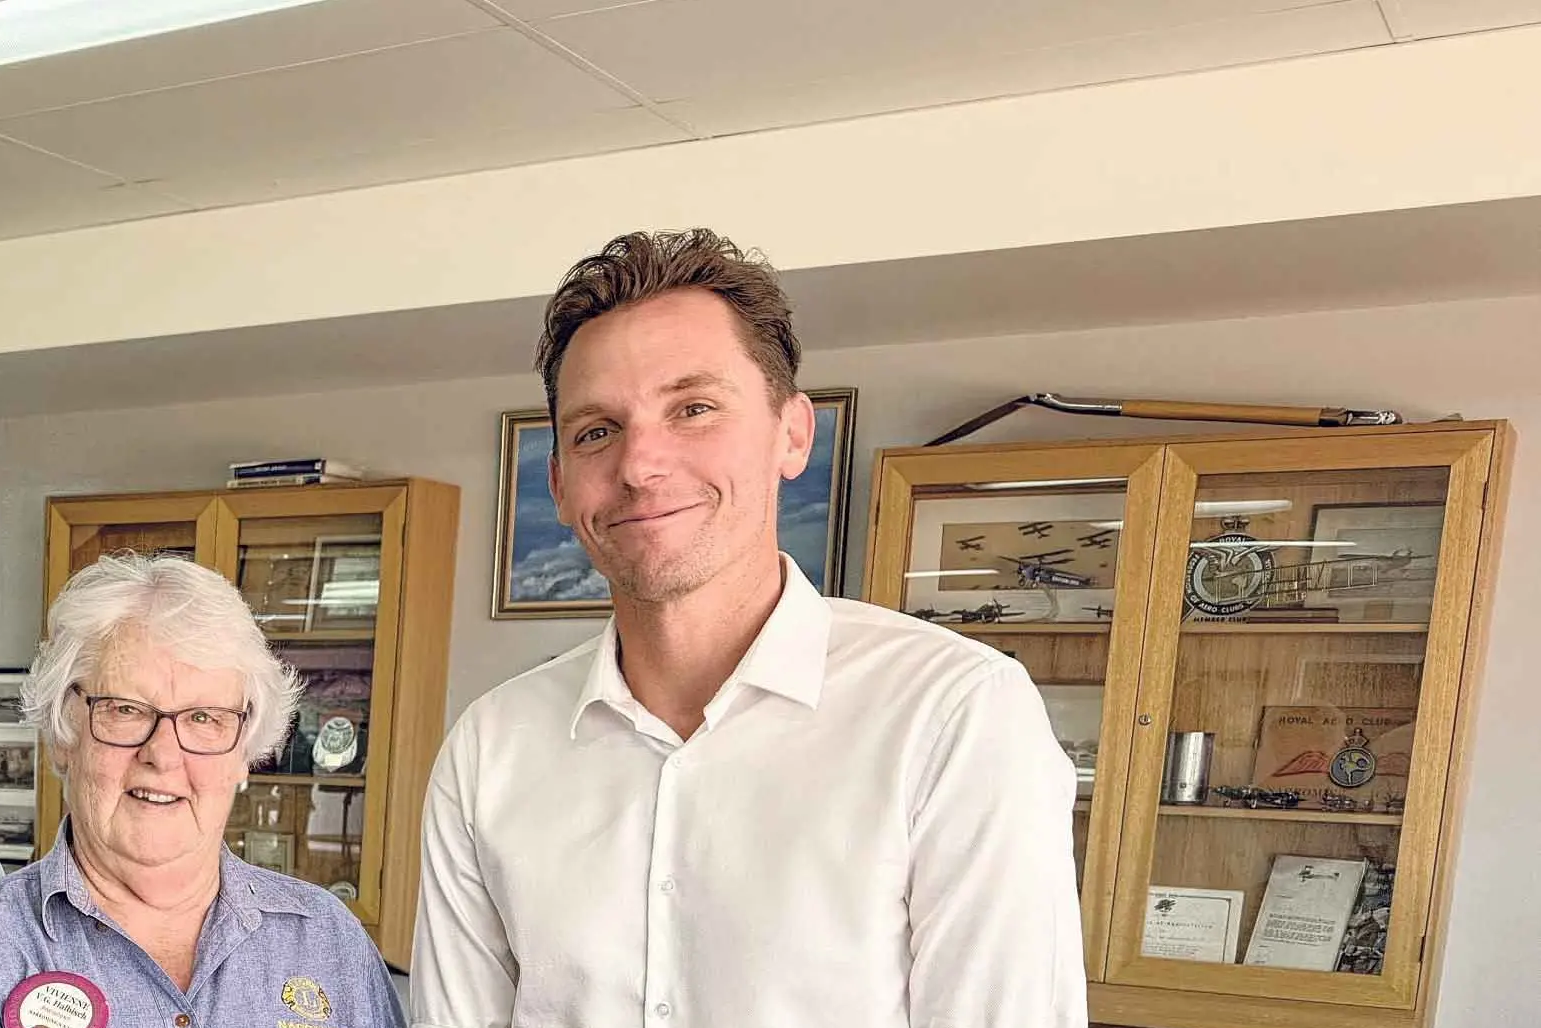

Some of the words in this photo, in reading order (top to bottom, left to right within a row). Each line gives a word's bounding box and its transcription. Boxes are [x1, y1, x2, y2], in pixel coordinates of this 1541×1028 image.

[1279, 715, 1314, 726] ROYAL
[1322, 717, 1354, 726] AEO
[46, 986, 90, 1011] VIVIENNE
